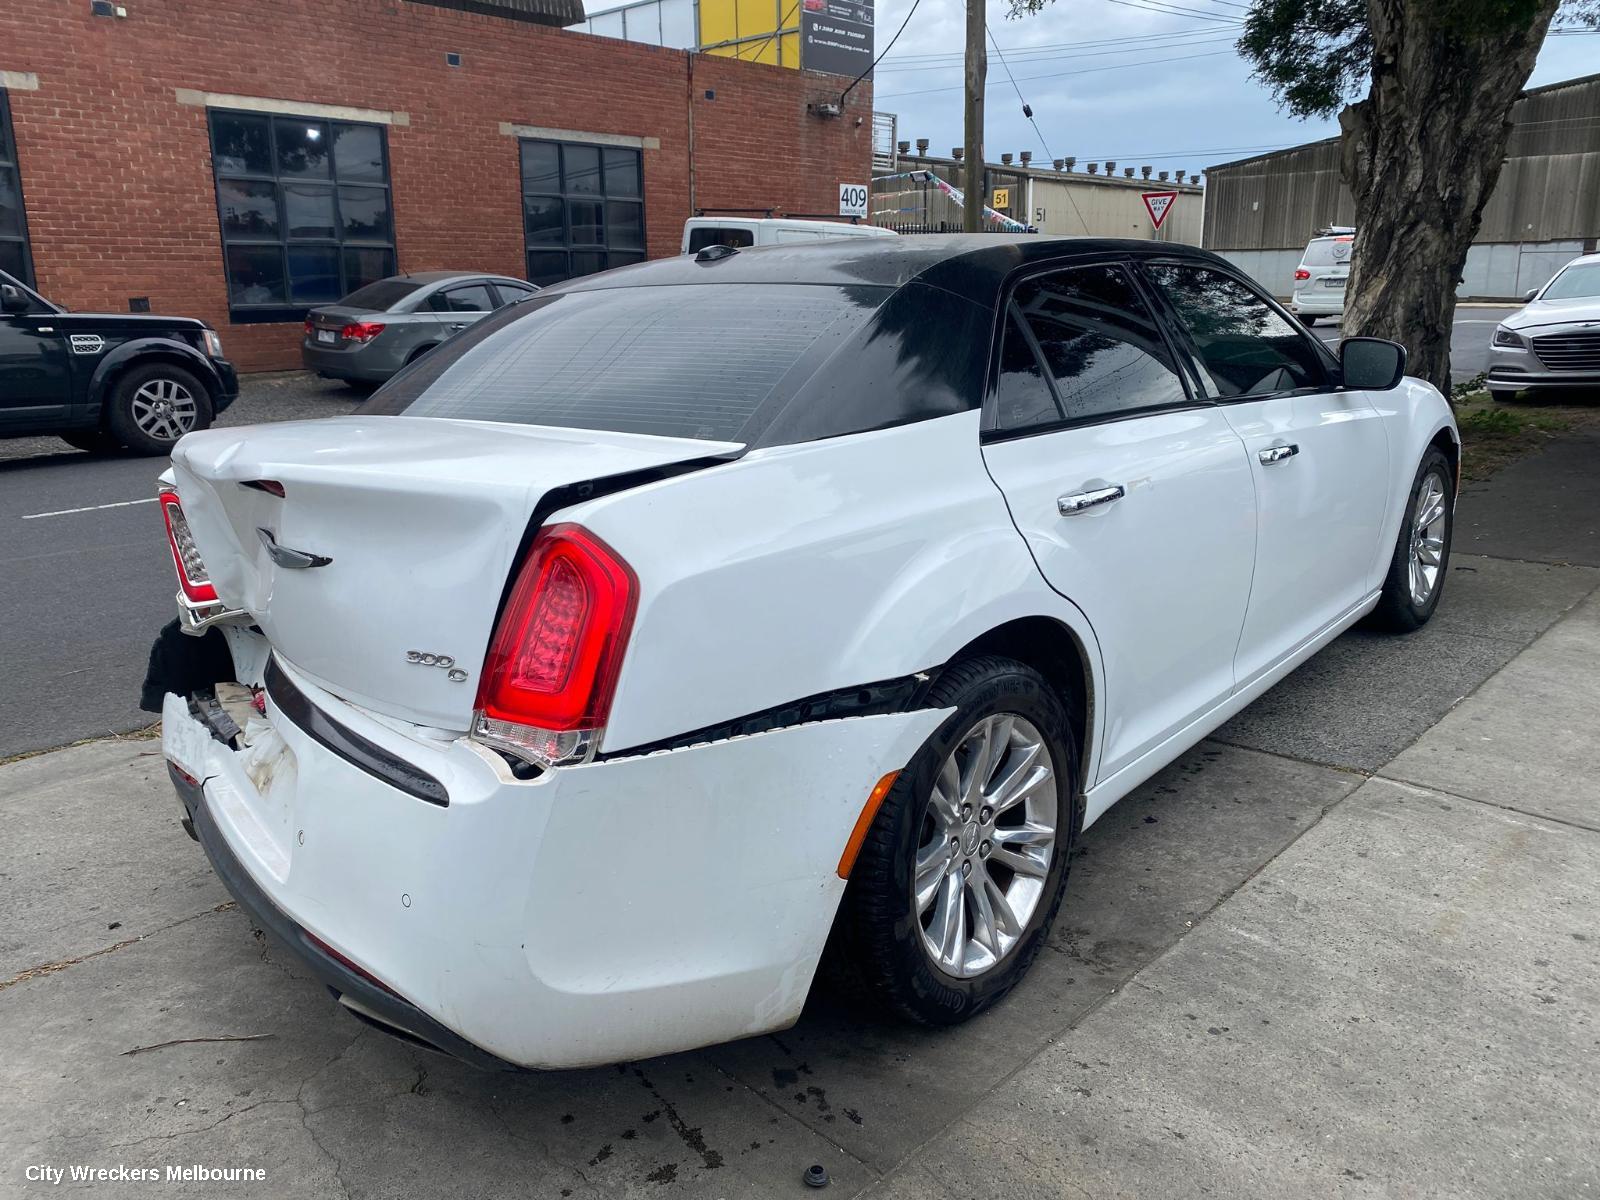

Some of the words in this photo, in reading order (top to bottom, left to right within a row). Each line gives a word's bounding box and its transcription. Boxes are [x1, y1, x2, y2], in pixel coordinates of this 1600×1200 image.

[841, 187, 866, 207] 409
[995, 193, 1006, 204] 51
[1036, 208, 1046, 222] 51
[406, 650, 455, 668] 300
[447, 667, 469, 682] C
